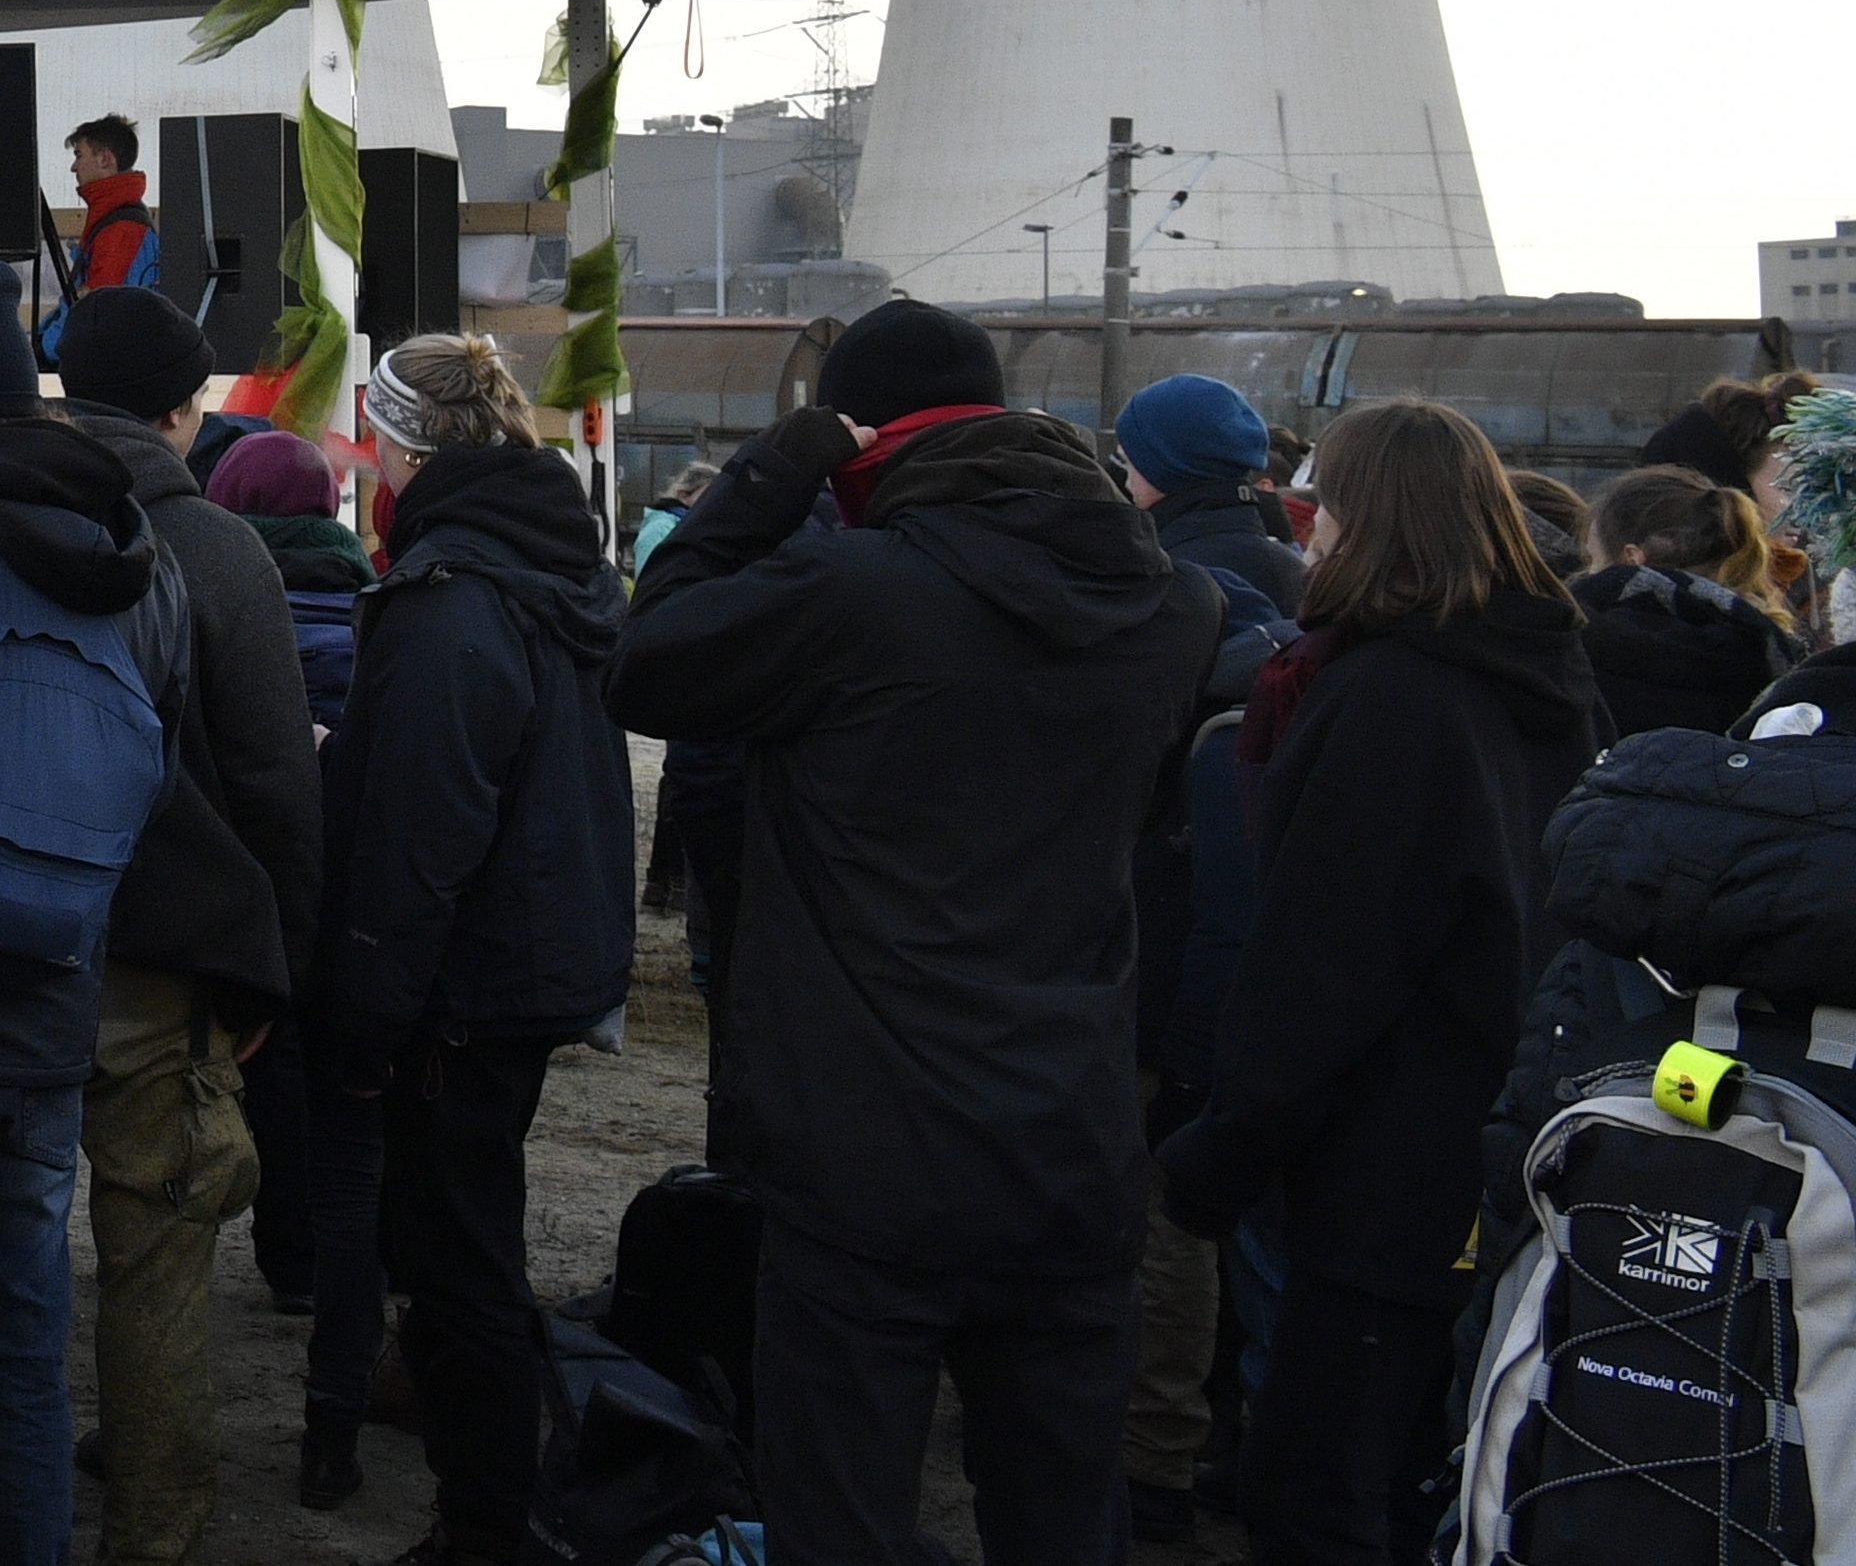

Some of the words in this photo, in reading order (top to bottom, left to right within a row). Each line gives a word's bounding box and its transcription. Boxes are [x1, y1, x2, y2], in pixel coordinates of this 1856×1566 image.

[1618, 1259, 1710, 1293] karrimor
[1577, 1356, 1614, 1377] Nova
[1618, 1366, 1674, 1391] Octavia
